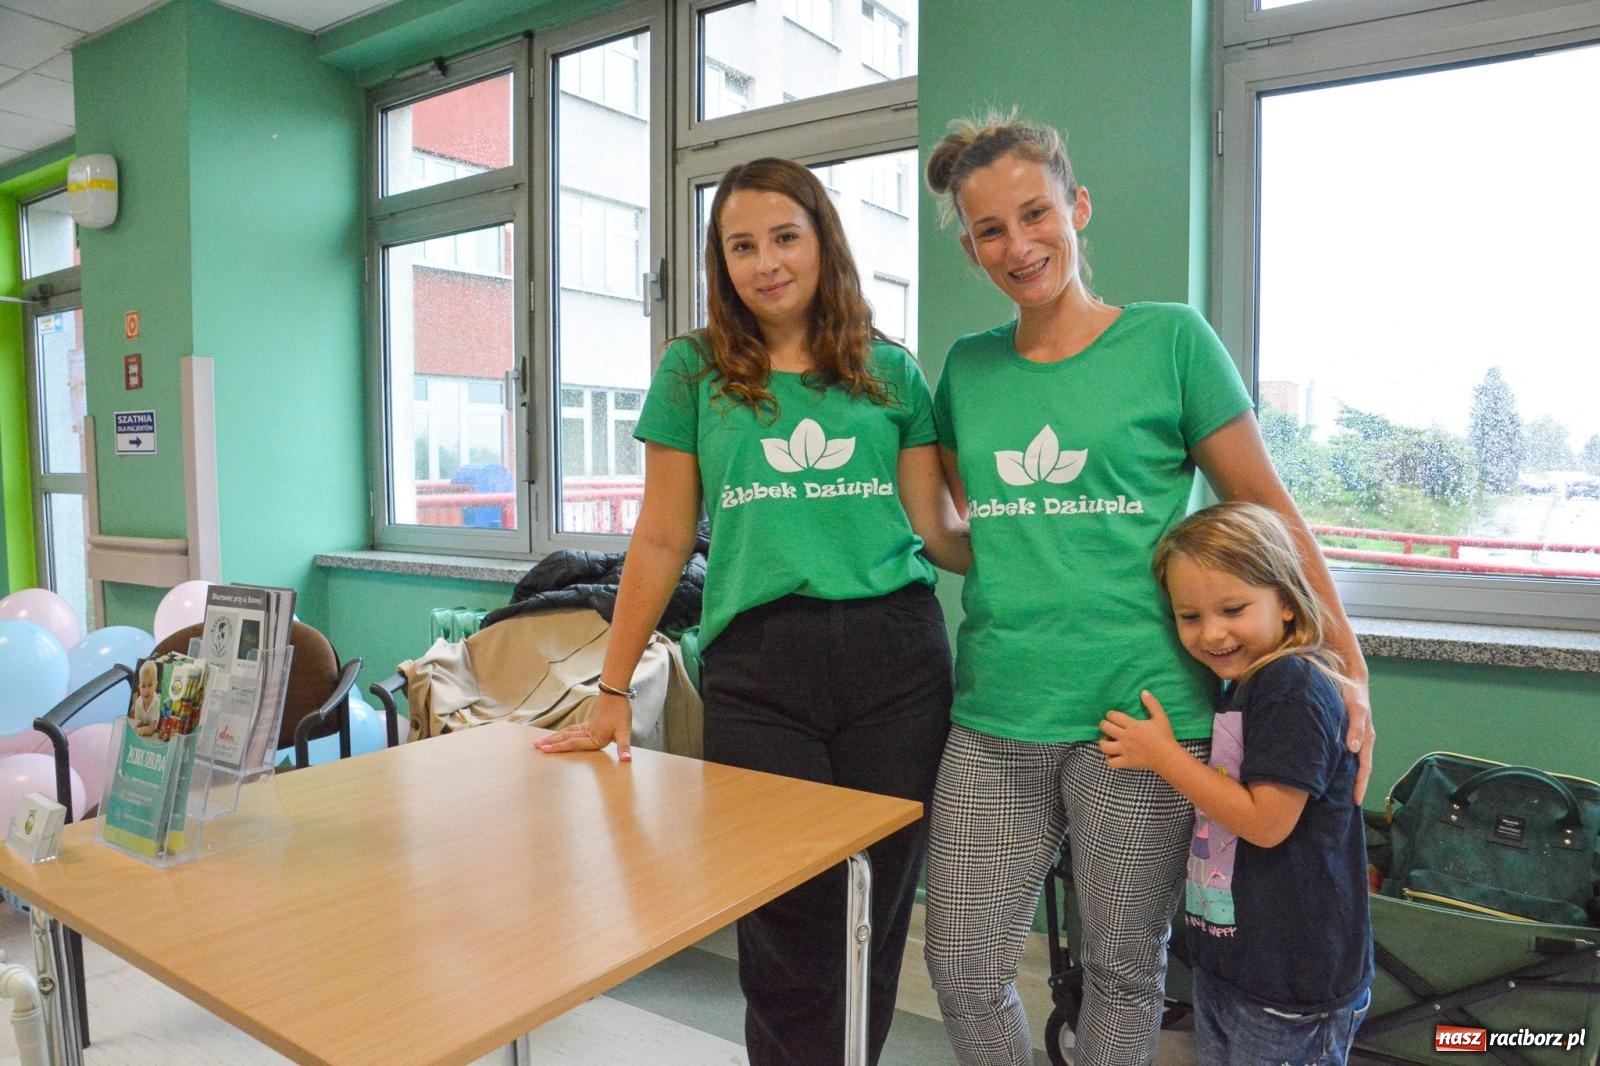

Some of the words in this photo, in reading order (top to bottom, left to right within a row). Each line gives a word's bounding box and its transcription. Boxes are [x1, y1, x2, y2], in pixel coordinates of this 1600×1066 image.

[117, 414, 153, 424] SZATNIA
[803, 477, 894, 499] Dziupla
[1043, 494, 1145, 515] Dziupla
